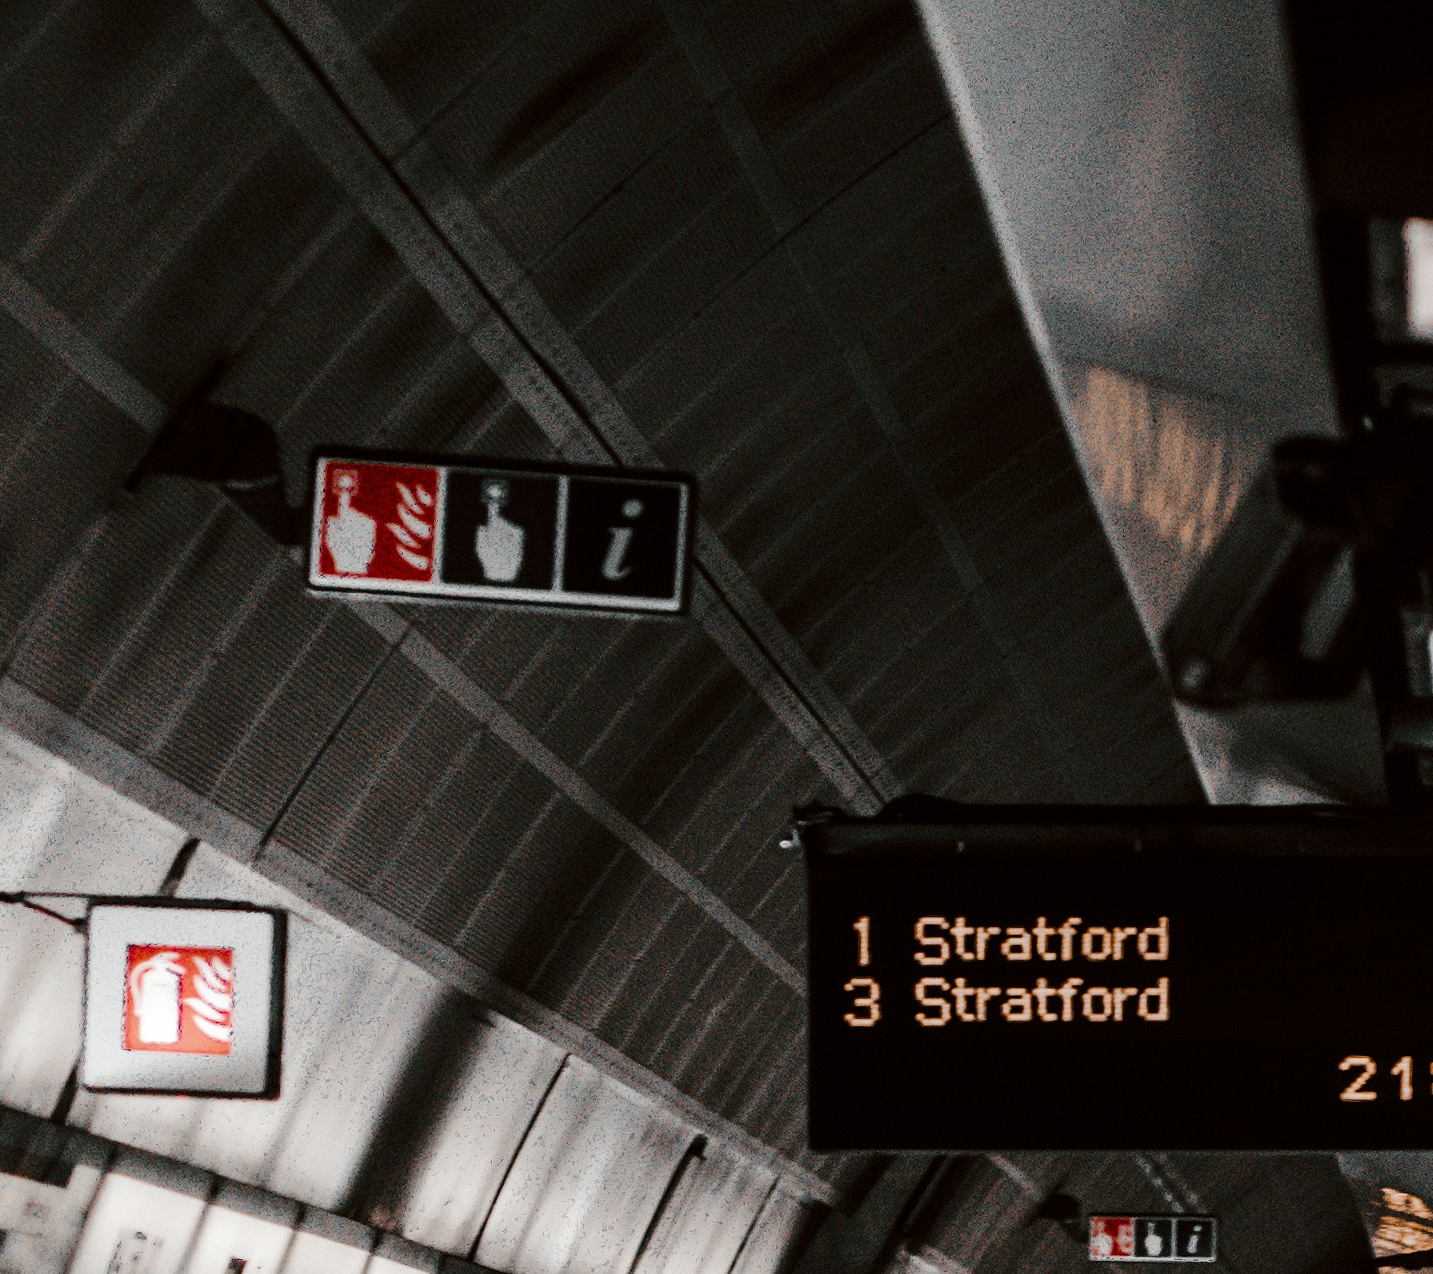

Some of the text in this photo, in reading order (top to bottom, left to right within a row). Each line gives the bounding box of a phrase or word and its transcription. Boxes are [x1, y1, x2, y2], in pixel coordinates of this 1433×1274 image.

[852, 915, 1170, 967] 1 Stratford
[843, 977, 881, 1028] 3
[913, 976, 1170, 1027] Stratford
